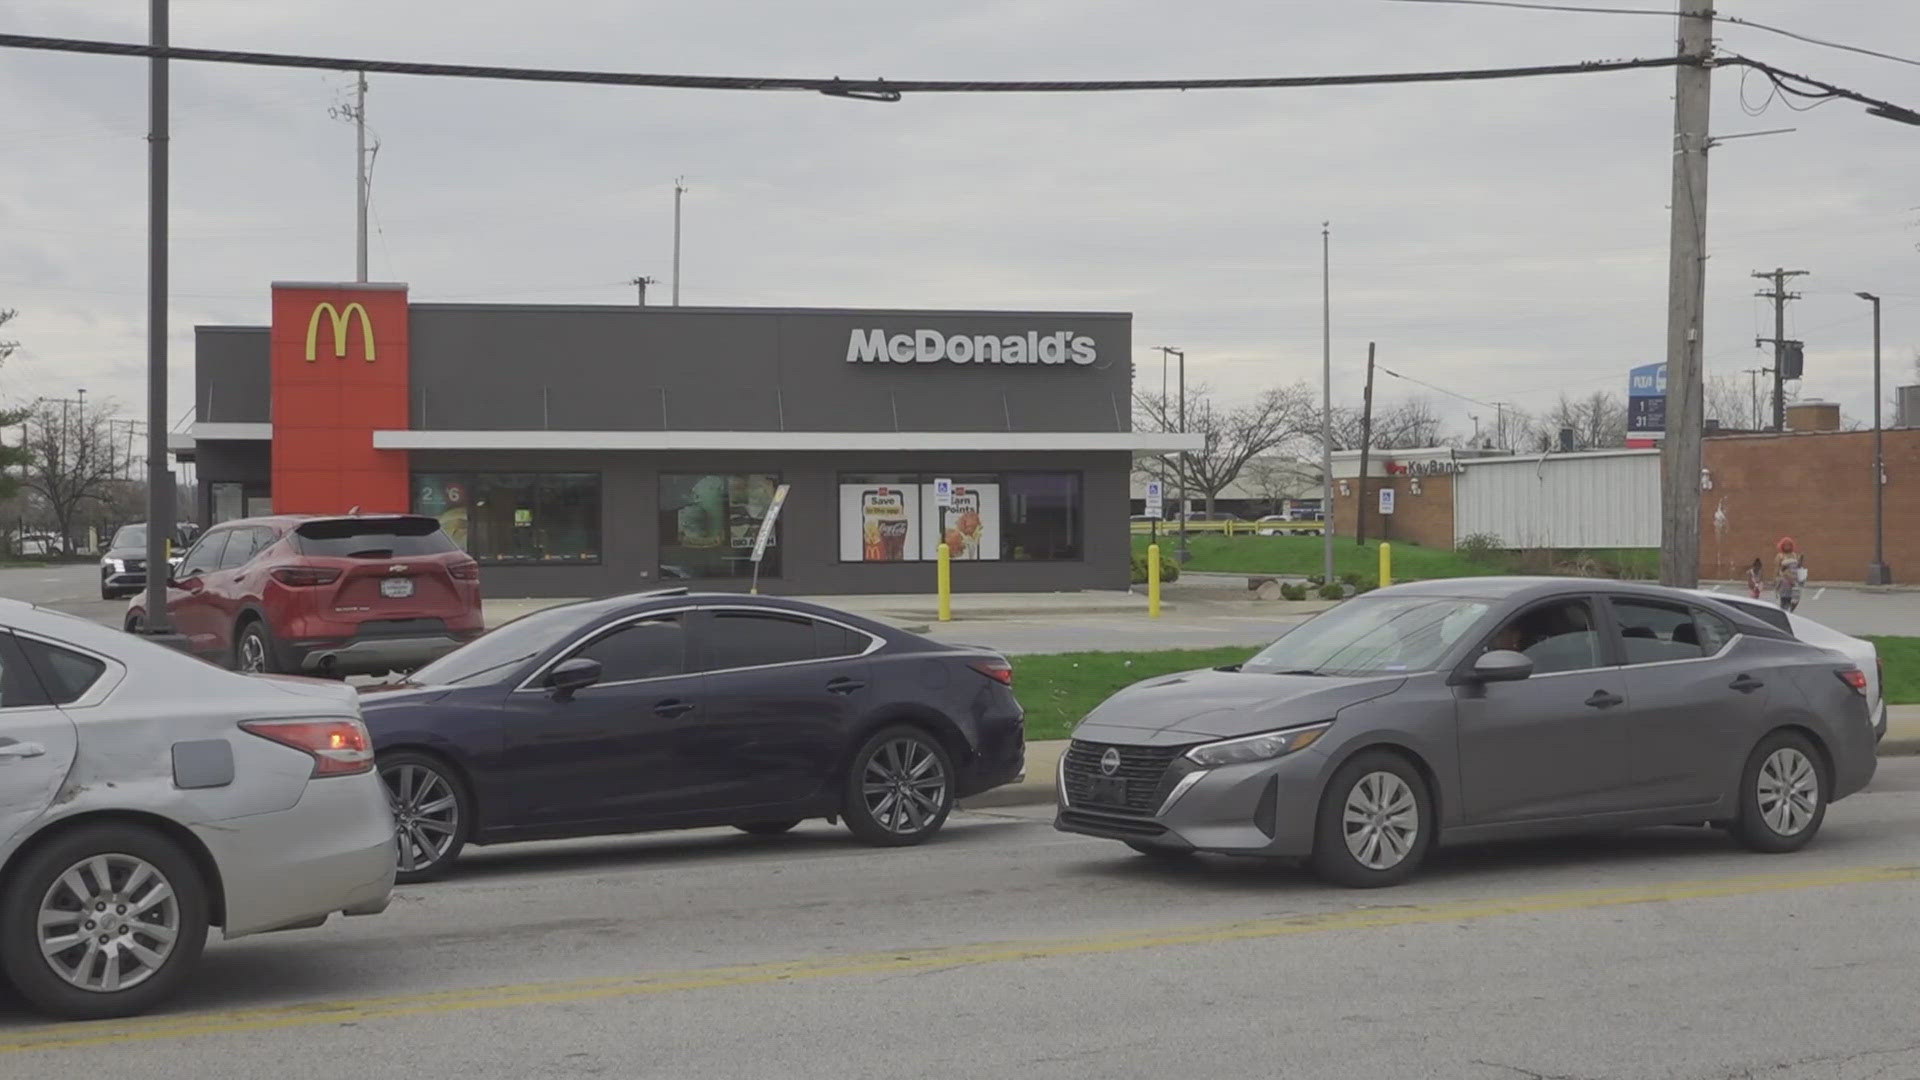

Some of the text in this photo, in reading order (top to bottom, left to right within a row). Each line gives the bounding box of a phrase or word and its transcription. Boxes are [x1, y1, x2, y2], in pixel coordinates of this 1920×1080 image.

[846, 328, 1097, 364] McDonald's
[1635, 415, 1647, 427] 31
[1408, 460, 1461, 475] KeyBank
[871, 497, 895, 505] Save
[945, 505, 975, 513] Points
